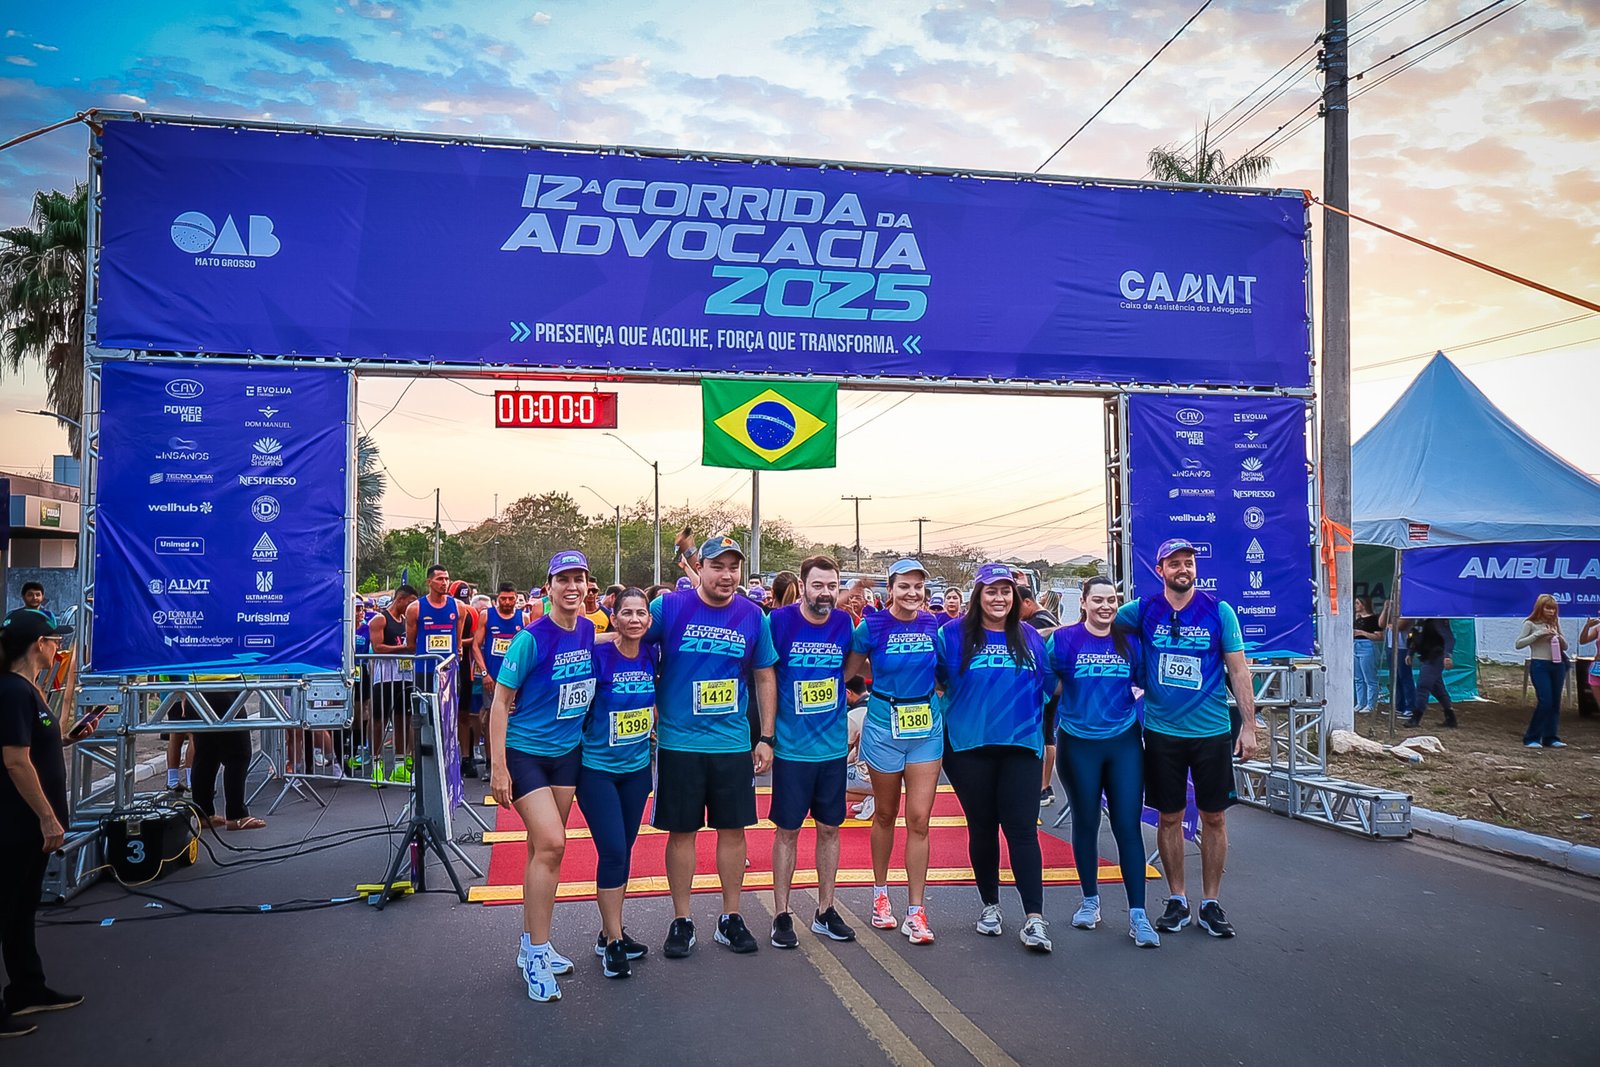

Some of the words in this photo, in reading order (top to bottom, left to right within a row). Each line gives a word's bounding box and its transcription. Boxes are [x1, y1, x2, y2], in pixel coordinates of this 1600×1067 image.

[602, 179, 867, 227] CORRIDA
[876, 213, 912, 228] DA
[171, 211, 280, 257] OAB
[501, 213, 926, 270] ADVOCACIA
[195, 257, 220, 266] MATO
[222, 258, 256, 268] GROSSO
[704, 265, 931, 322] 2025
[1120, 270, 1257, 305] CAAMT
[1120, 301, 1141, 309] Caixa
[1154, 303, 1195, 311] Assistência
[1212, 306, 1252, 315] Advogados
[535, 322, 615, 348] PRESENÇA
[618, 326, 648, 346] QUE
[652, 327, 713, 350] ACOLHE,
[717, 330, 764, 352] FORÇA
[768, 331, 796, 351] QUE
[800, 332, 899, 354] TRANSFORMA.
[171, 383, 198, 392] CAV
[164, 405, 202, 414] POWER
[1180, 412, 1199, 420] CAV
[181, 414, 203, 422] ADE
[1176, 431, 1203, 439] POWER
[162, 452, 210, 460] INSANOS
[238, 475, 296, 486] NESPRESSO
[1232, 489, 1276, 498] NESPRESSO
[148, 503, 198, 512] wellhub
[261, 503, 272, 514] D
[1170, 514, 1206, 522] wellhub
[1250, 513, 1258, 522] D
[168, 579, 210, 590] ALMT
[1194, 578, 1217, 588] LMT
[237, 612, 290, 622] Puríssima
[683, 630, 746, 644] ADVOCACIA
[698, 625, 738, 636] CORRIDA
[430, 640, 448, 648] 1221
[679, 637, 746, 658] 2025
[886, 642, 934, 654] 2025
[788, 654, 843, 668] 2025
[552, 660, 592, 680] 2025
[1074, 664, 1130, 678] 2025
[1168, 664, 1192, 678] 594
[612, 681, 656, 694] 2025
[568, 690, 588, 706] 698
[702, 689, 732, 704] 1412
[803, 688, 832, 702] 1399
[618, 718, 648, 734] 1398
[900, 714, 928, 728] 1380
[127, 840, 146, 864] 3
